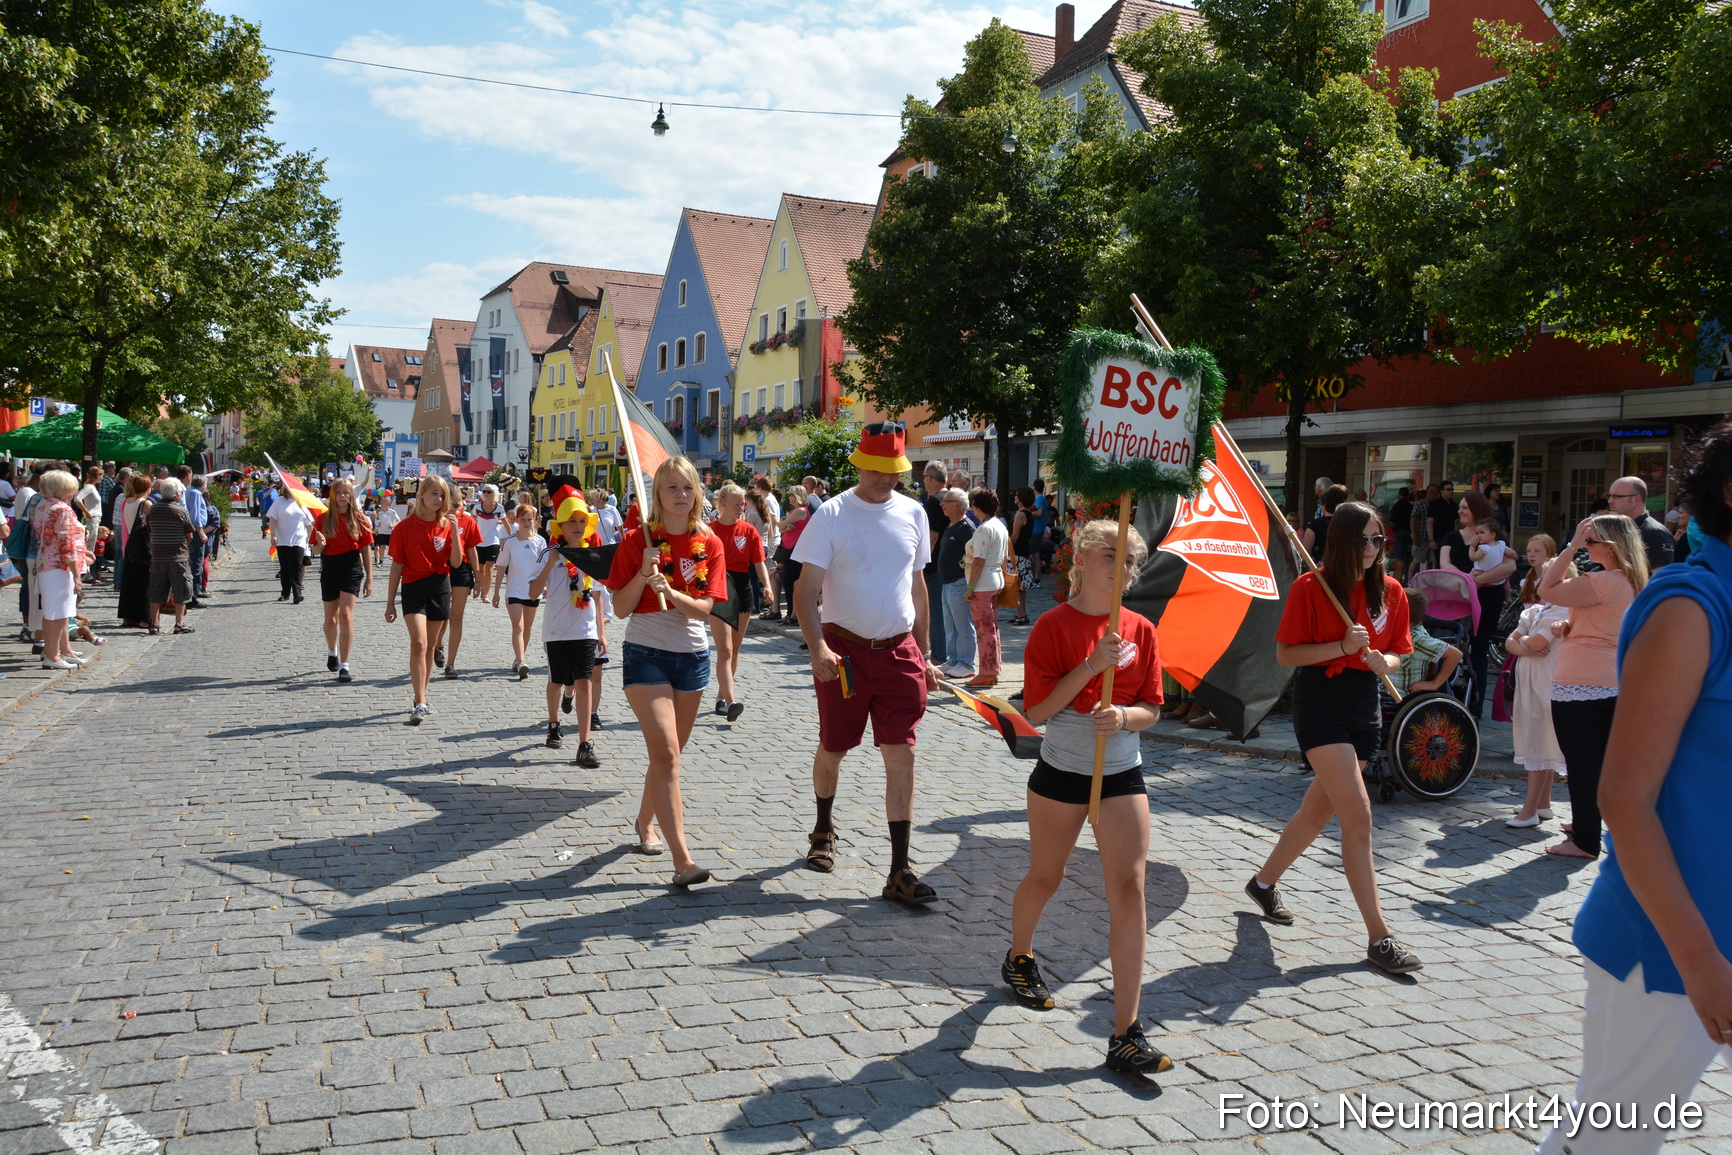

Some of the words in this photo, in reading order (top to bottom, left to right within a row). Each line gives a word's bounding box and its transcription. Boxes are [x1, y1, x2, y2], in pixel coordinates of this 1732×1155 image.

[1100, 365, 1182, 420] BSC
[32, 399, 41, 413] P
[553, 397, 565, 409] HOTEL
[1611, 429, 1653, 437] Behandlung
[1084, 418, 1191, 467] Woffenbach
[745, 446, 753, 460] P
